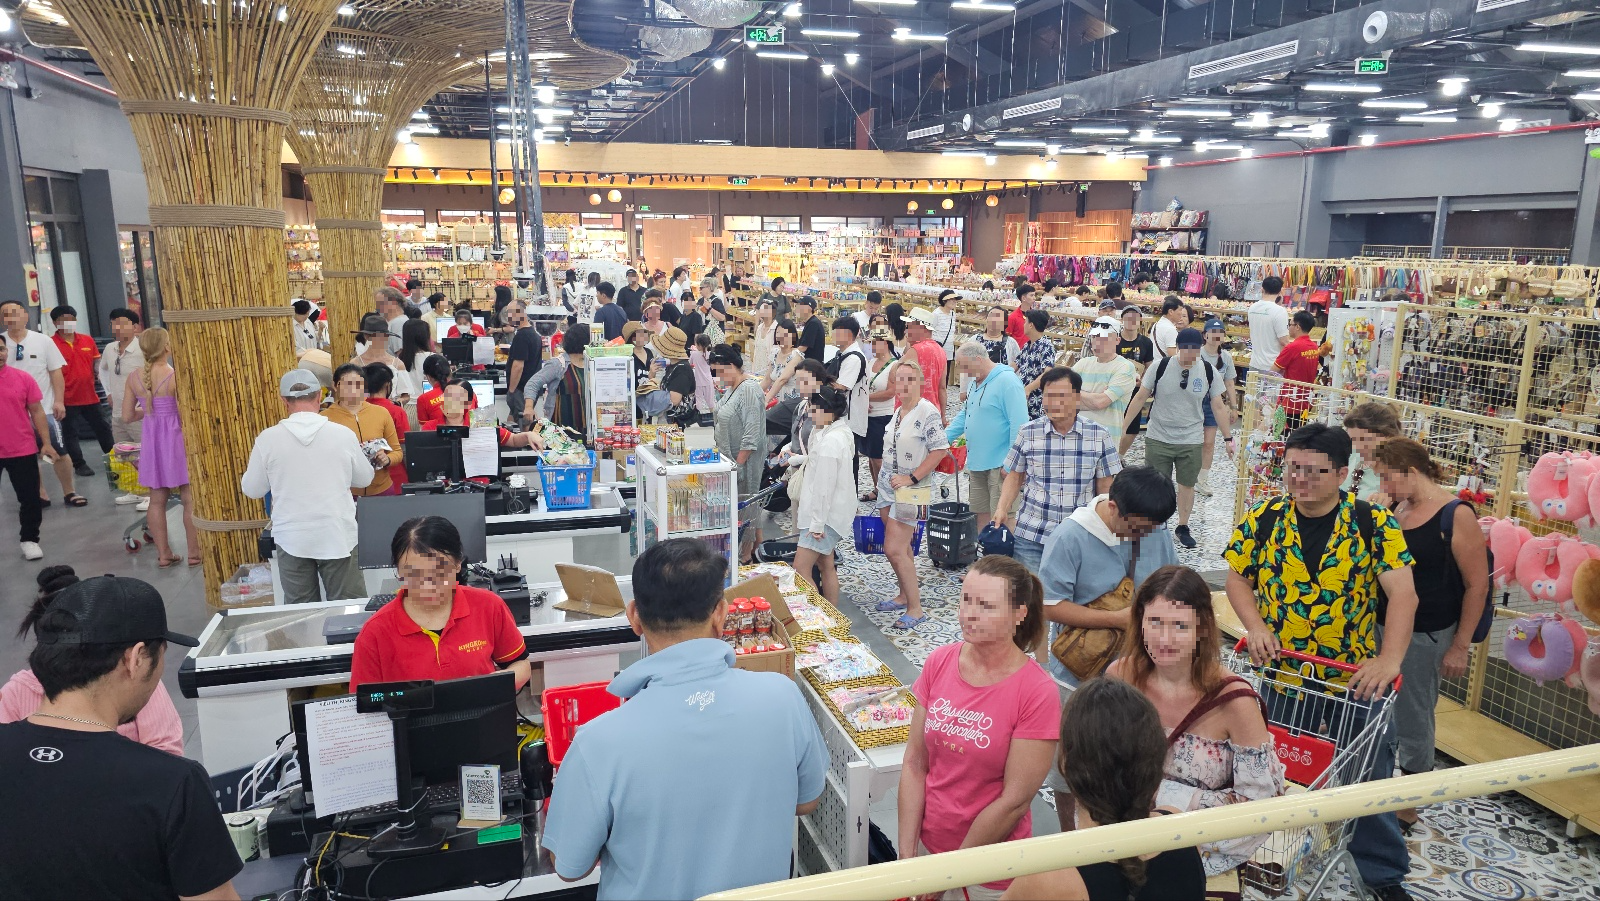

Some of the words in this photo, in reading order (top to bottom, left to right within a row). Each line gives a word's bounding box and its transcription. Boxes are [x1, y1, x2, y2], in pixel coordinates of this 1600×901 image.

[929, 697, 956, 722] Less
[953, 708, 993, 730] sugar
[935, 738, 964, 755] LYRA
[940, 720, 991, 749] chocolate
